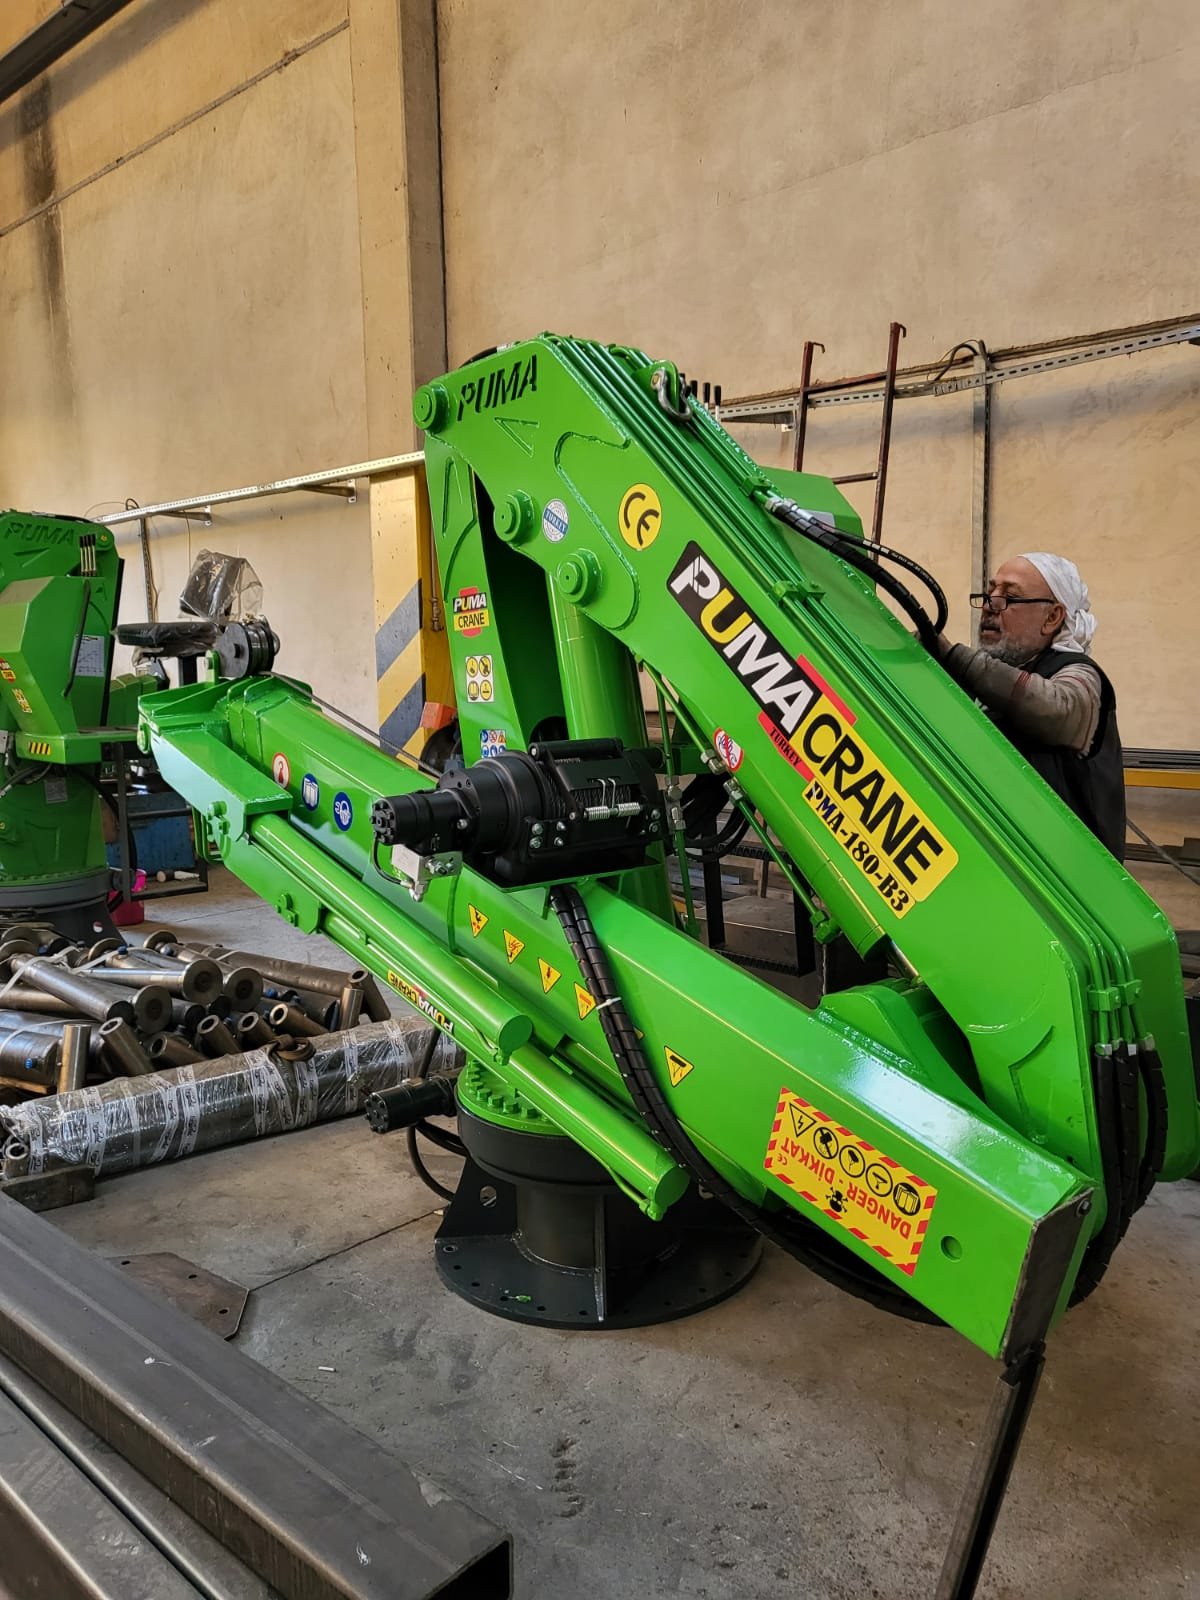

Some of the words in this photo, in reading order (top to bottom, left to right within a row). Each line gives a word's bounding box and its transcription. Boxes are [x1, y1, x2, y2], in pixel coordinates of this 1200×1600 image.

[457, 354, 538, 422] PUMA
[3, 522, 76, 545] PUMA
[453, 592, 487, 613] PUMA
[458, 612, 486, 628] CRANE
[670, 556, 814, 734] PUMA
[802, 713, 944, 886] CRANE
[770, 727, 802, 767] TURKEY
[805, 780, 910, 912] PMA-180-B3
[389, 972, 418, 1005] CRANE
[418, 996, 454, 1033] PUMA
[781, 1137, 836, 1183] DİKKAT
[846, 1182, 912, 1240] DANGER
